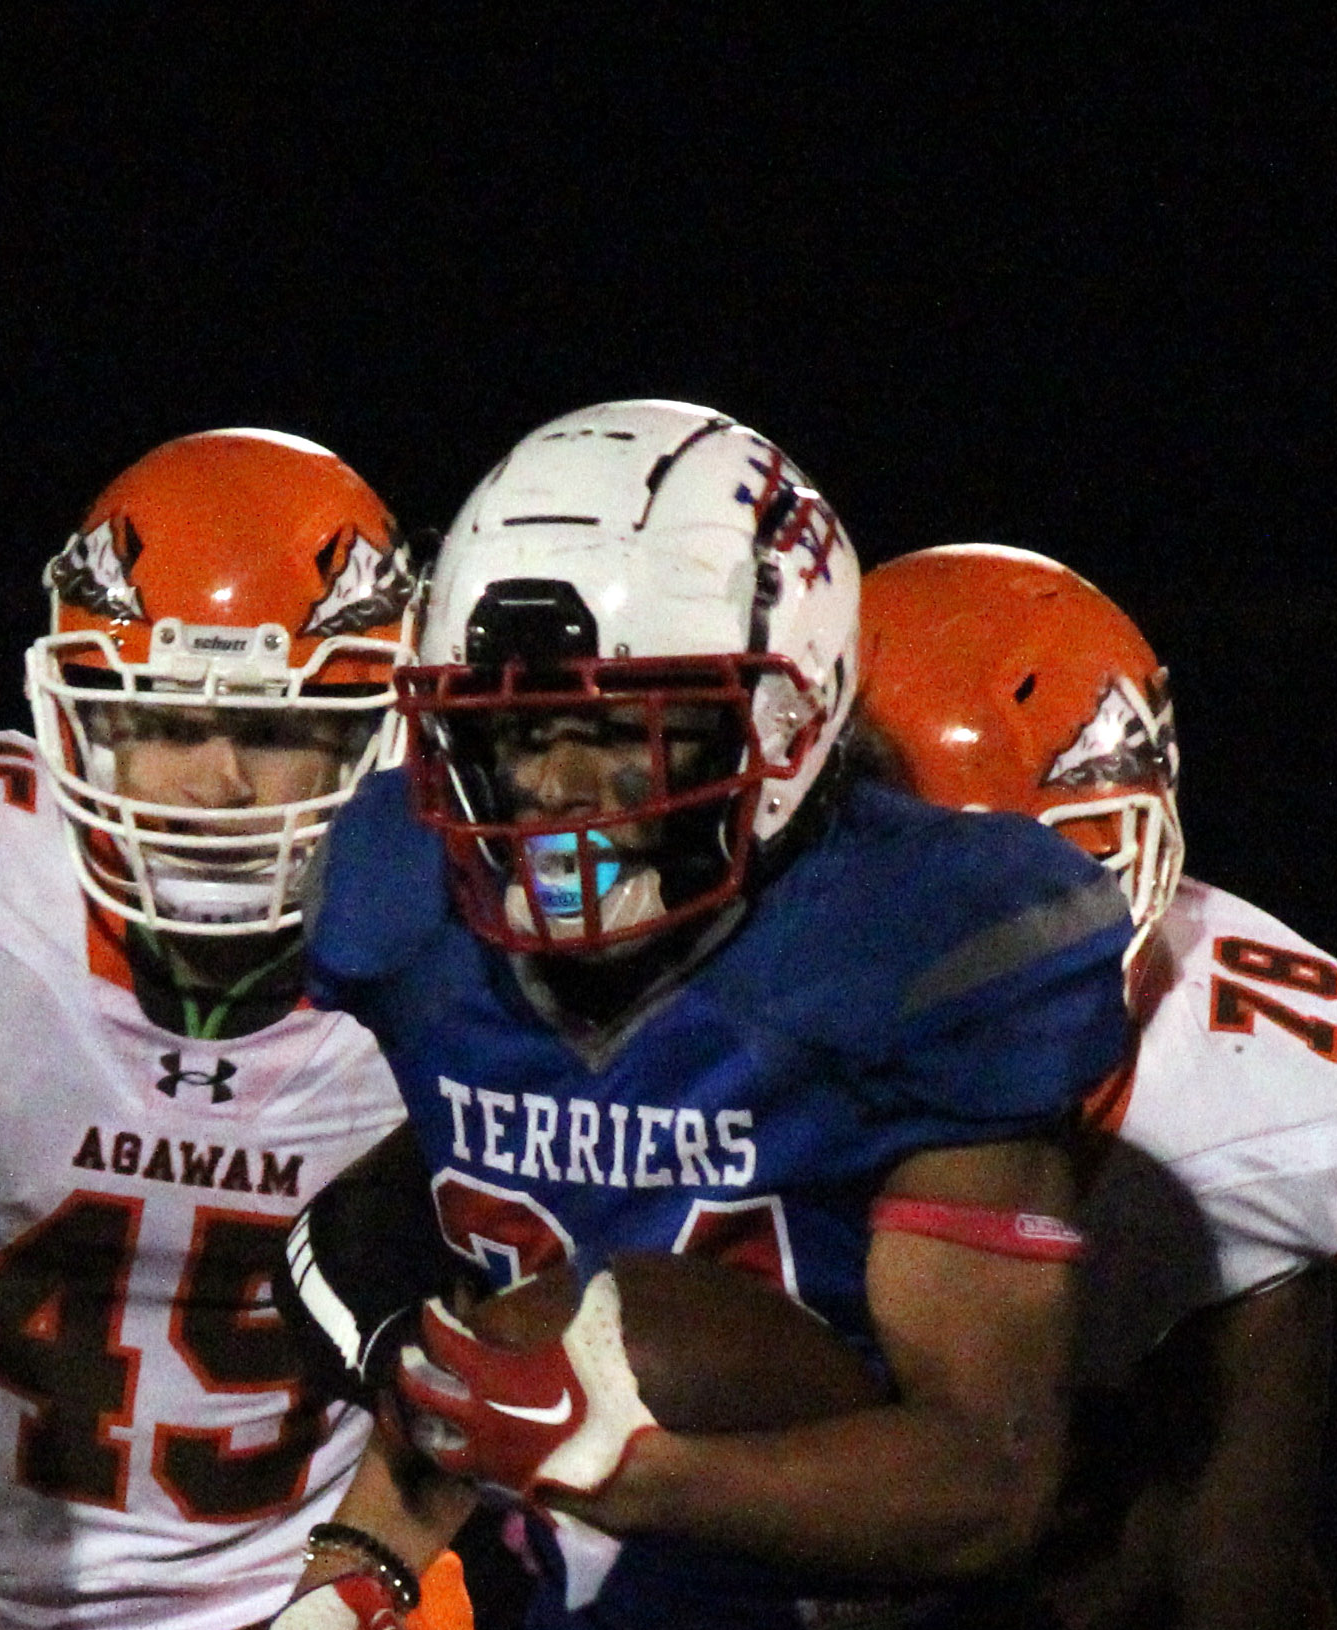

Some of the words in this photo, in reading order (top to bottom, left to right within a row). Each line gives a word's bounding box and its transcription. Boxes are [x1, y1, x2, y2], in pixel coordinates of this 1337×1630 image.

[193, 636, 247, 651] schutt
[72, 1126, 304, 1198] AGAWAM
[437, 1075, 758, 1190] TERRIERS
